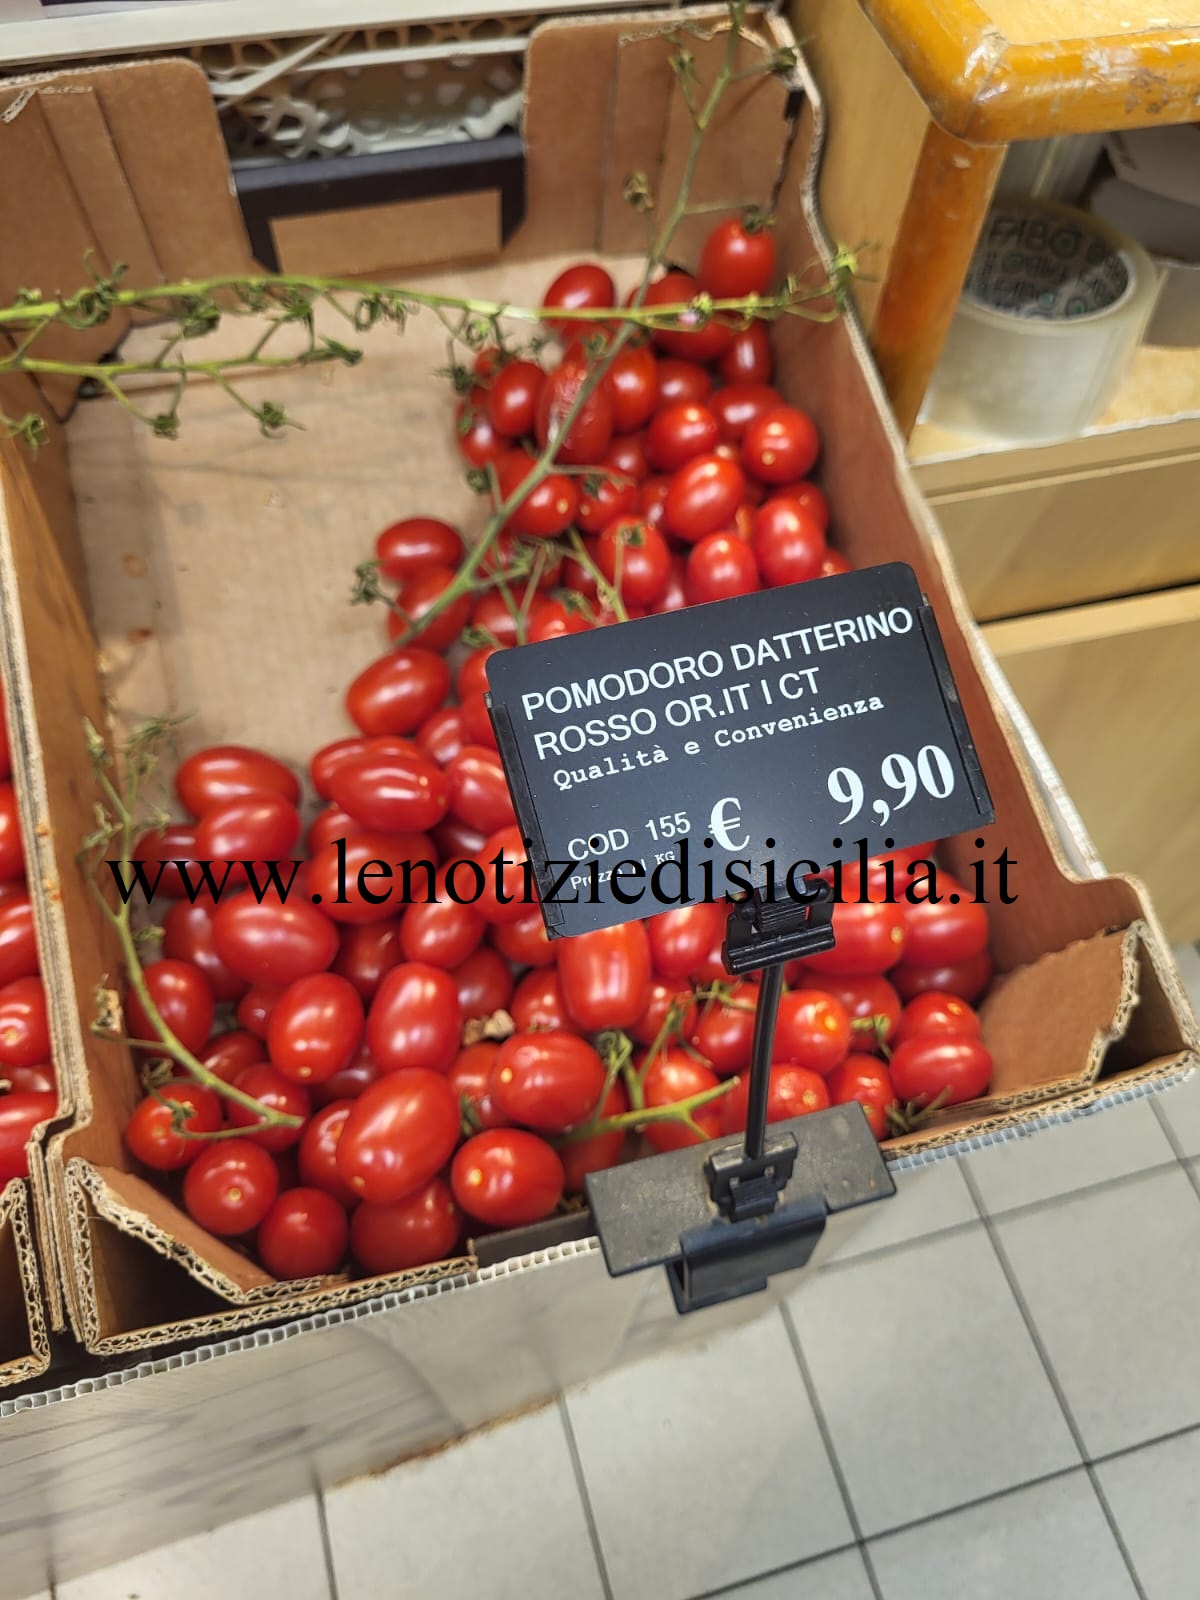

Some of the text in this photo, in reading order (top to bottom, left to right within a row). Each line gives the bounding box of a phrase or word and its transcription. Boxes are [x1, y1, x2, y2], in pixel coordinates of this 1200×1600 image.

[521, 607, 913, 721] POMODORO DATTERINO
[533, 708, 657, 760] ROSSO
[664, 683, 751, 727] OR.IT
[779, 667, 820, 700] CT
[553, 696, 885, 791] Qualità e Convenienza
[567, 811, 691, 861] COD 155
[707, 745, 955, 851] € 9,90
[654, 850, 676, 865] KG
